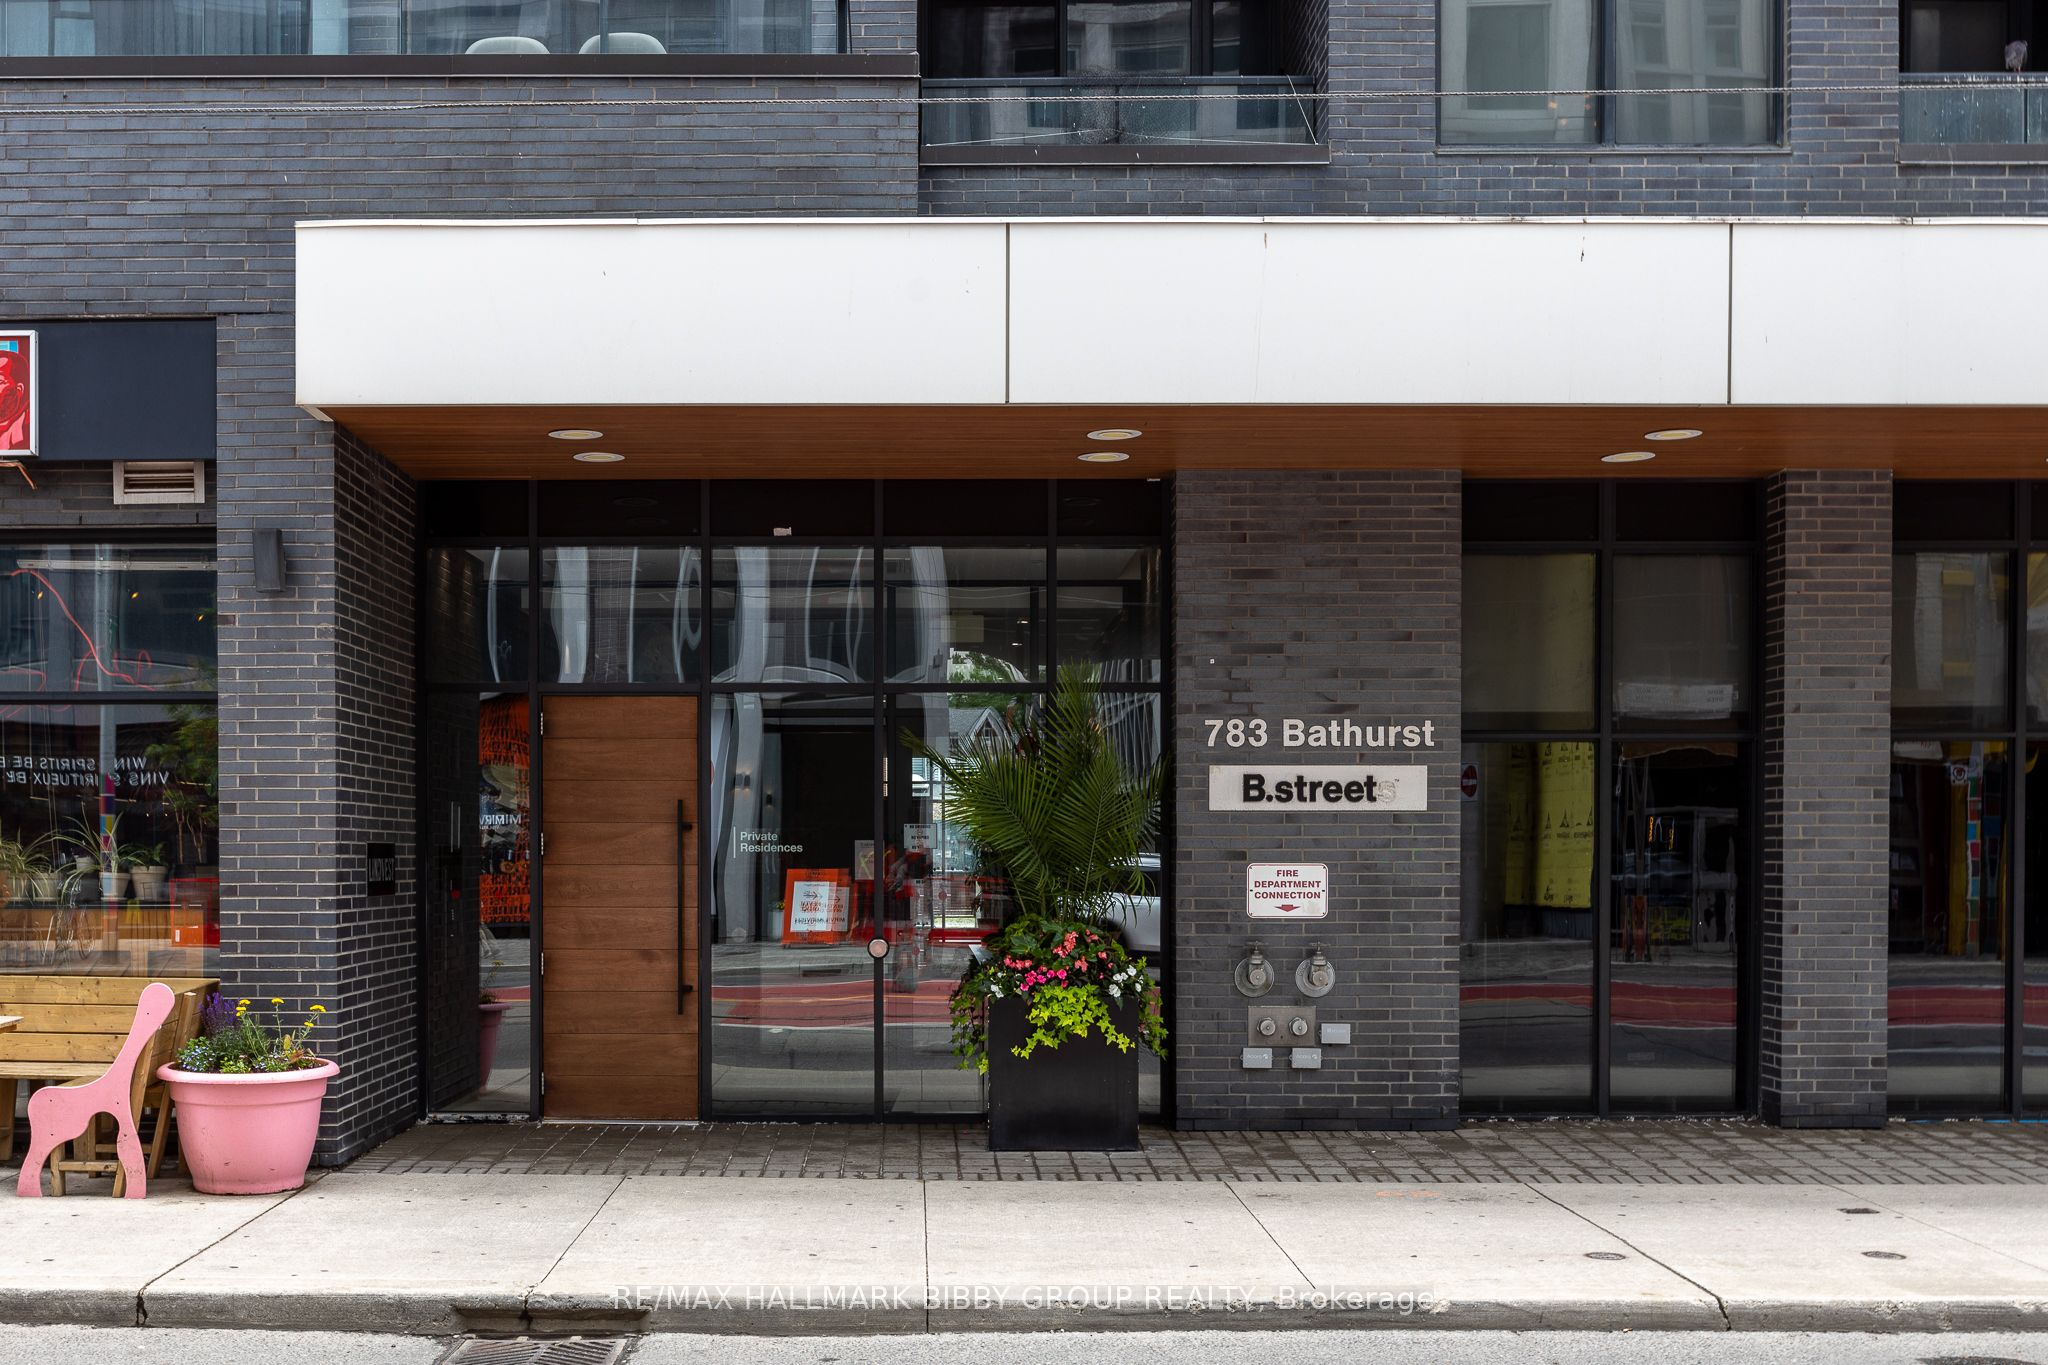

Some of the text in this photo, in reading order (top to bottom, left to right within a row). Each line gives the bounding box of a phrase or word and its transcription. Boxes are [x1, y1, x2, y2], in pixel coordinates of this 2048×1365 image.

[1204, 718, 1435, 747] 783 Bathurst
[740, 831, 778, 841] Private
[740, 842, 804, 853] Residences
[1276, 869, 1299, 877] FIRE
[1254, 880, 1322, 888] DEPARTMENT
[1254, 891, 1321, 899] CONNECTION
